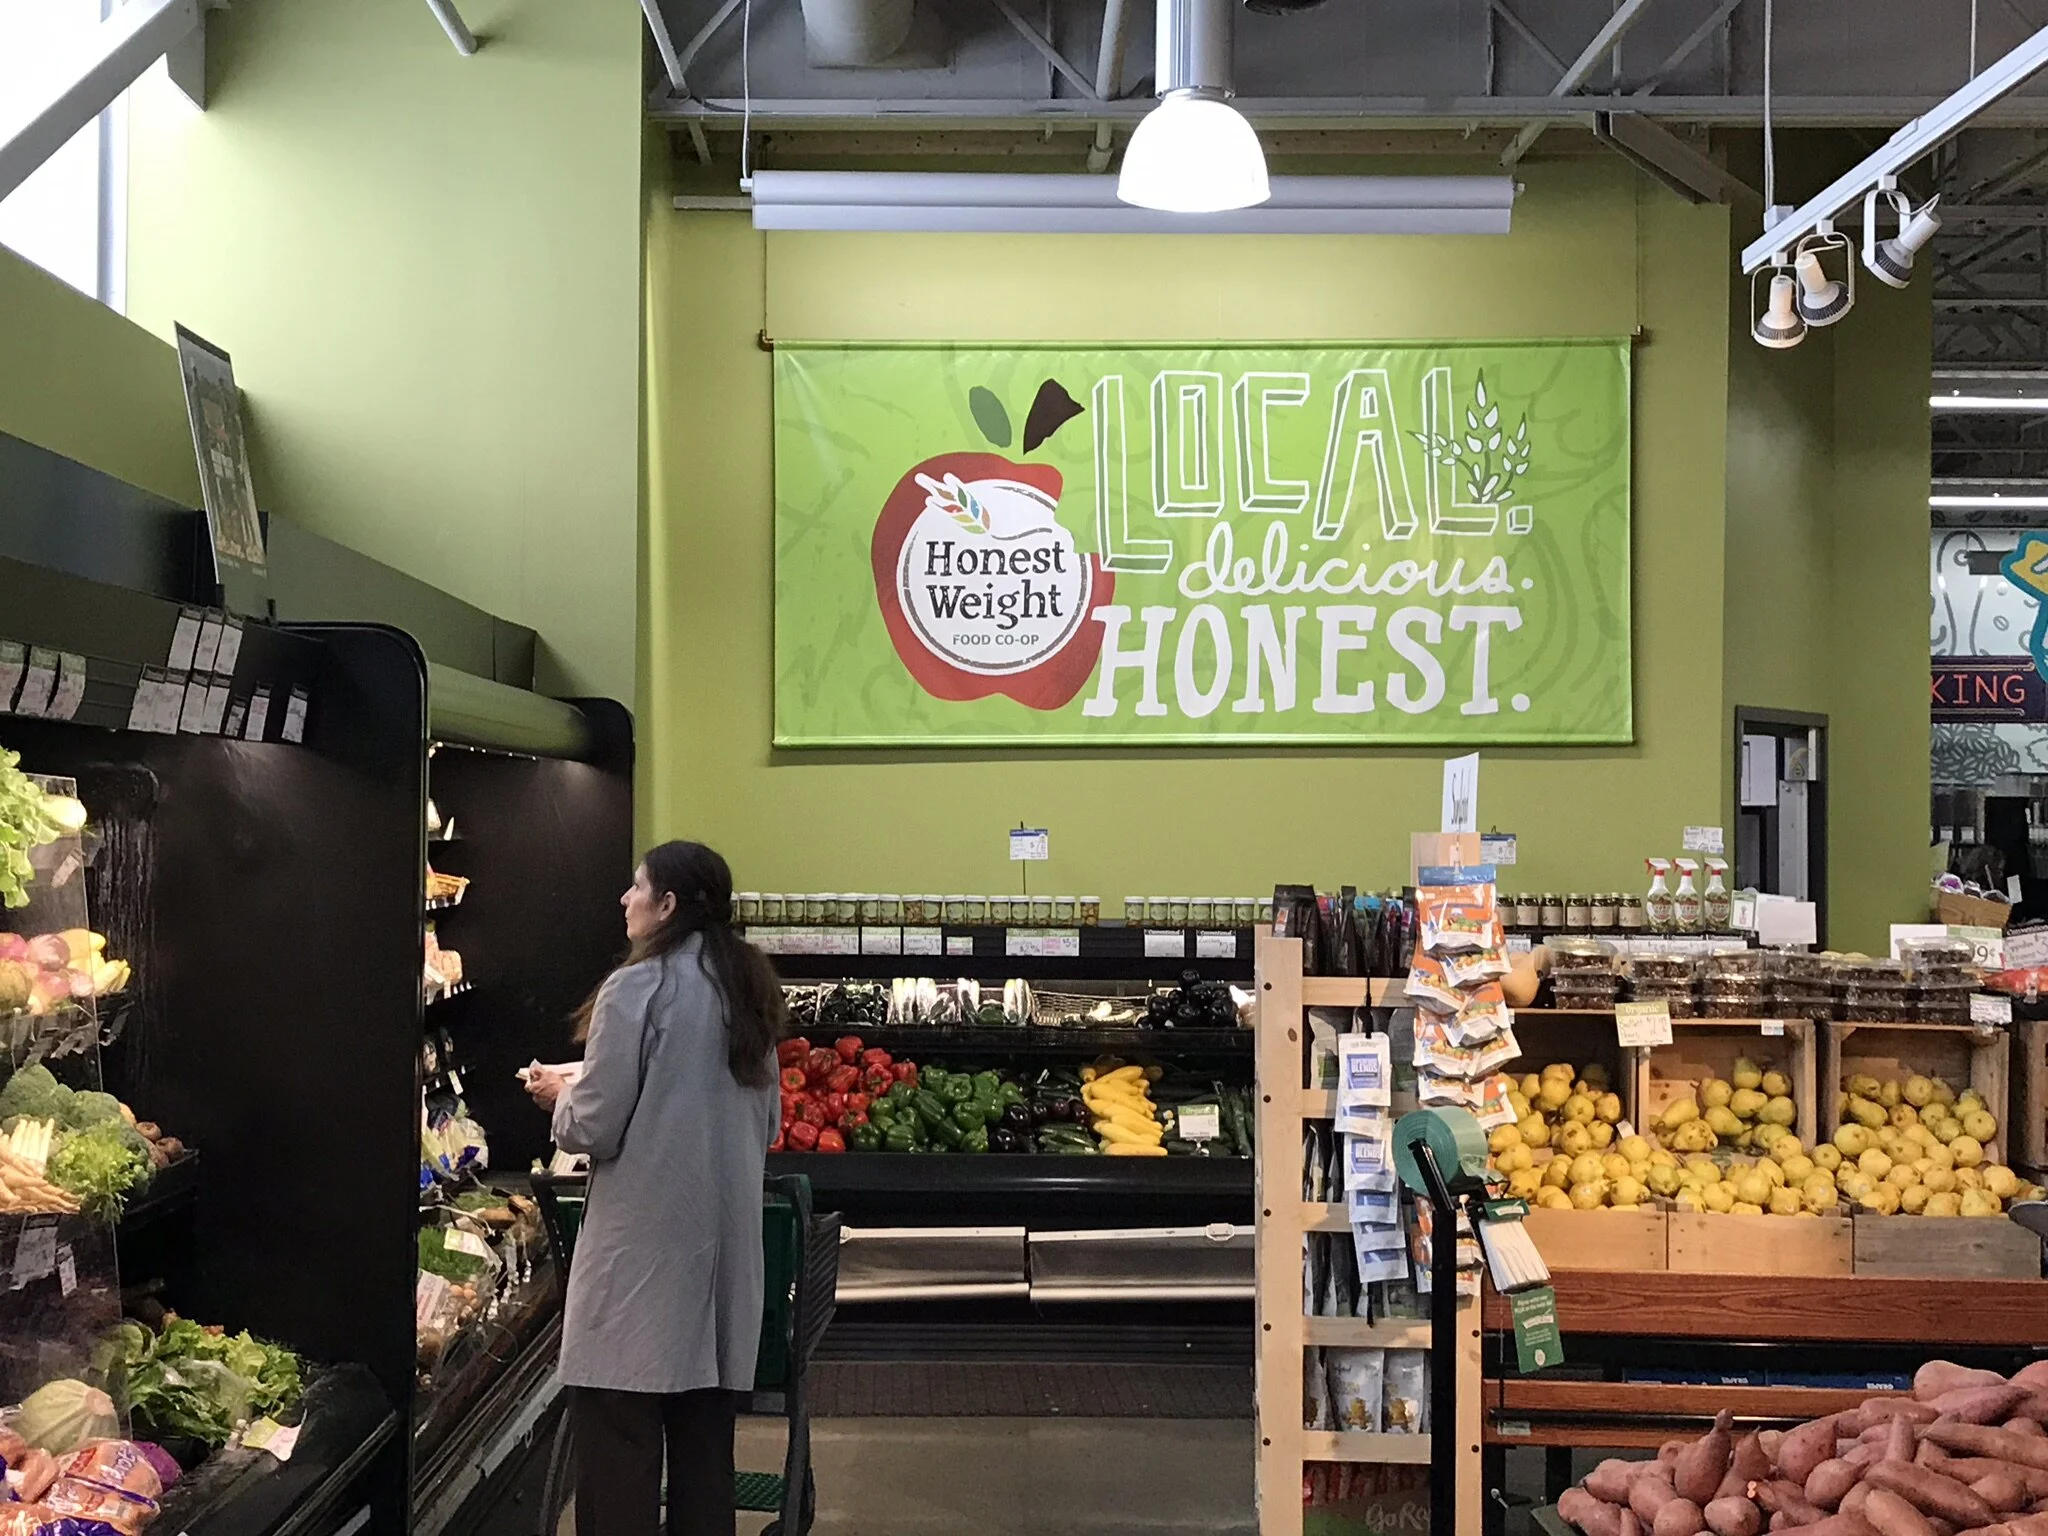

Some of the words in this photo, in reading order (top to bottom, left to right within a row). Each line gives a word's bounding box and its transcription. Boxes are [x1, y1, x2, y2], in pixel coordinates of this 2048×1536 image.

[1092, 366, 1534, 574] LOCAL.
[925, 540, 1067, 577] Honest
[1177, 521, 1534, 600] delicious.
[926, 580, 1064, 631] Weight
[952, 634, 992, 646] FOOD
[994, 633, 1040, 646] CO-OP
[1082, 603, 1532, 719] HONEST.
[1624, 1003, 1661, 1014] Organic
